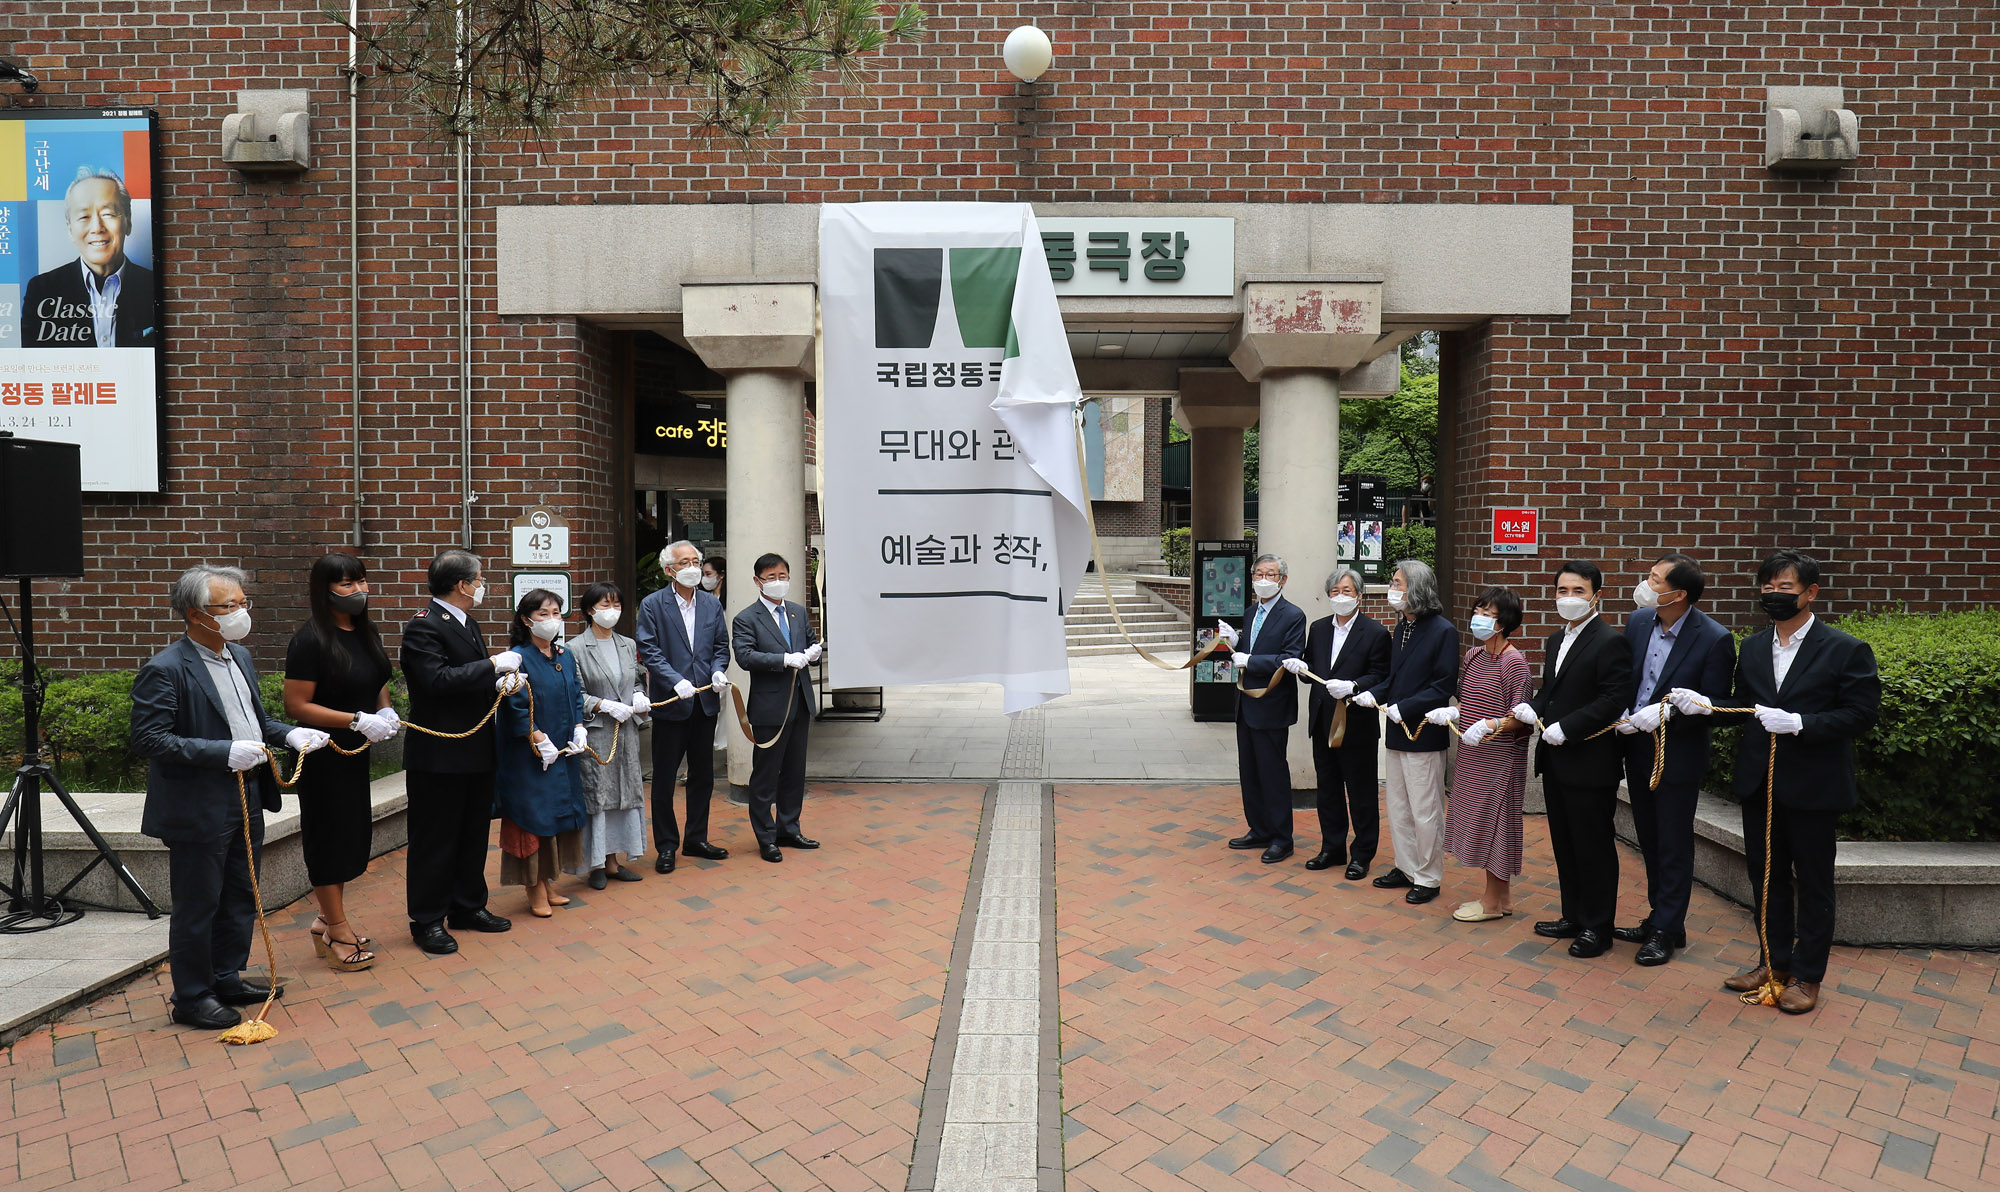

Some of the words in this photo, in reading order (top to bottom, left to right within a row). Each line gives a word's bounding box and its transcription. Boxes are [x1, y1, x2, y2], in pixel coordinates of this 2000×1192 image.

[33, 140, 51, 191] 금난새
[36, 296, 119, 319] Classic
[36, 320, 92, 342] Date
[1, 382, 44, 406] 정동
[51, 382, 117, 405] 팔레트
[655, 425, 694, 439] cafe
[879, 429, 981, 461] 무대와
[1501, 520, 1530, 533] 에스원
[528, 533, 552, 550] 43
[880, 533, 982, 566] 예술과
[993, 533, 1048, 572] 창작,
[532, 552, 550, 560] 정동길
